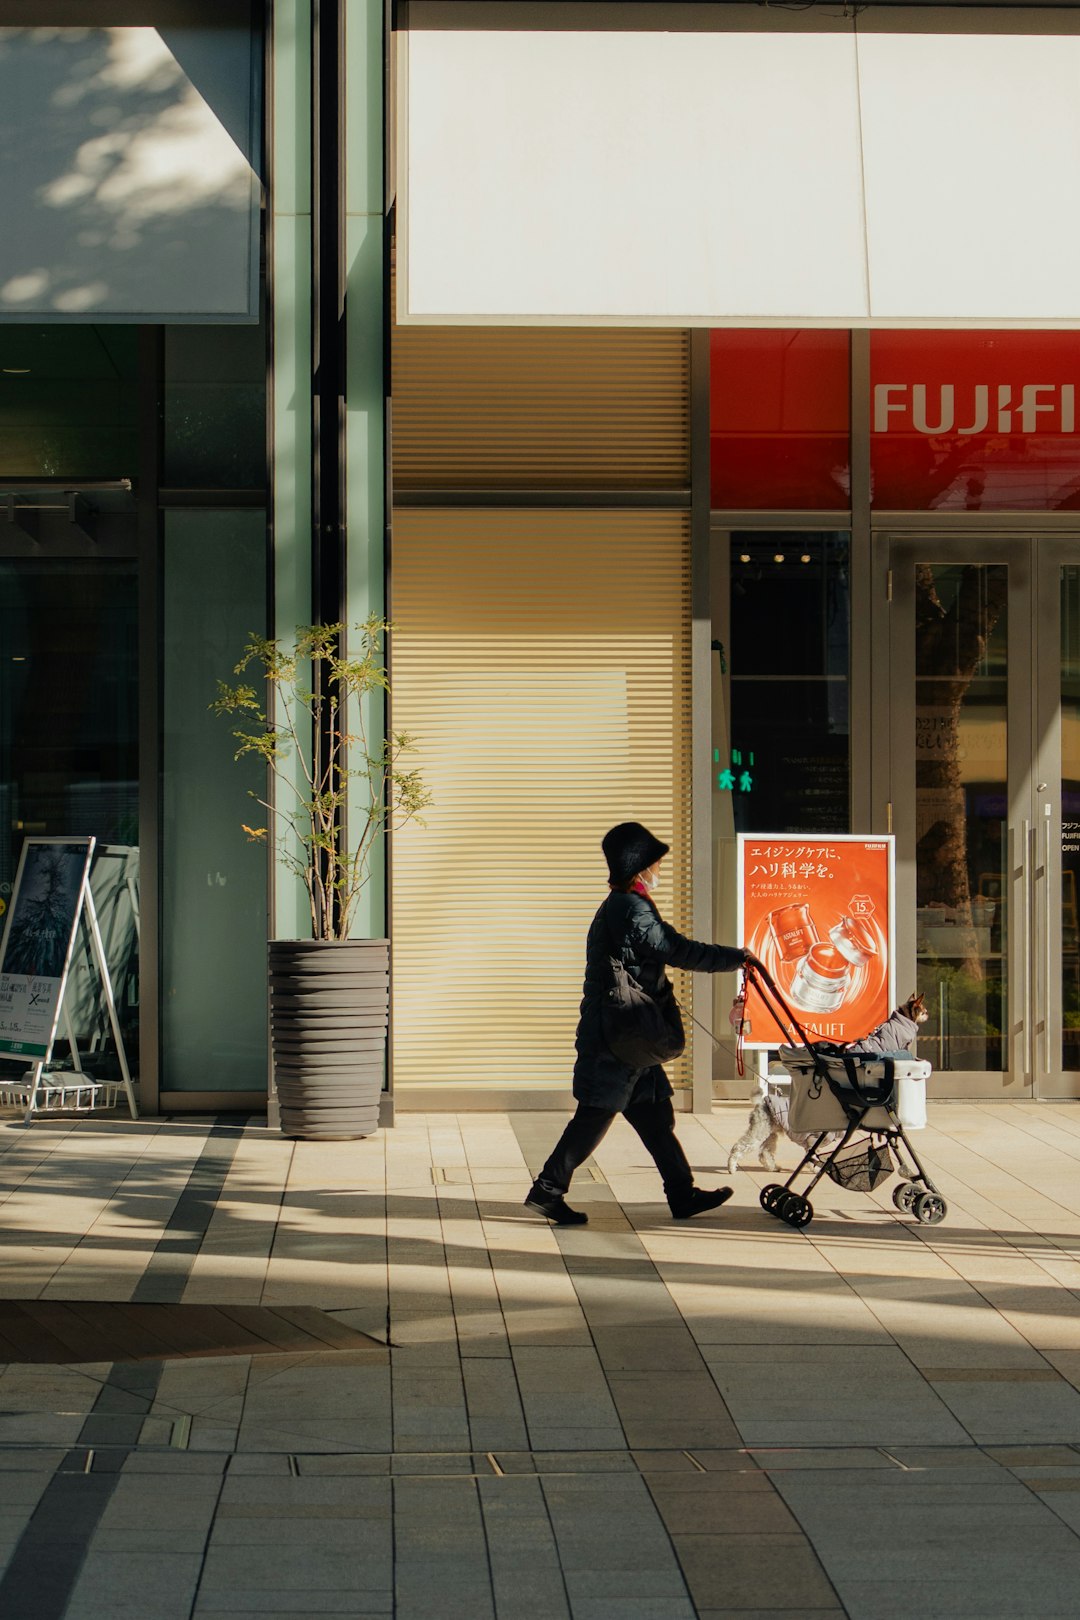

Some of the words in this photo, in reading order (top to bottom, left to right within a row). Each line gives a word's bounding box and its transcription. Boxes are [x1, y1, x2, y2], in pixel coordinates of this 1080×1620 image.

[874, 384, 1075, 435] FUJIFI
[750, 846, 841, 860] エイジングケアに、
[749, 861, 834, 879] ハリ科学を。
[855, 902, 866, 912] 15
[788, 1022, 846, 1036] ATALIFT
